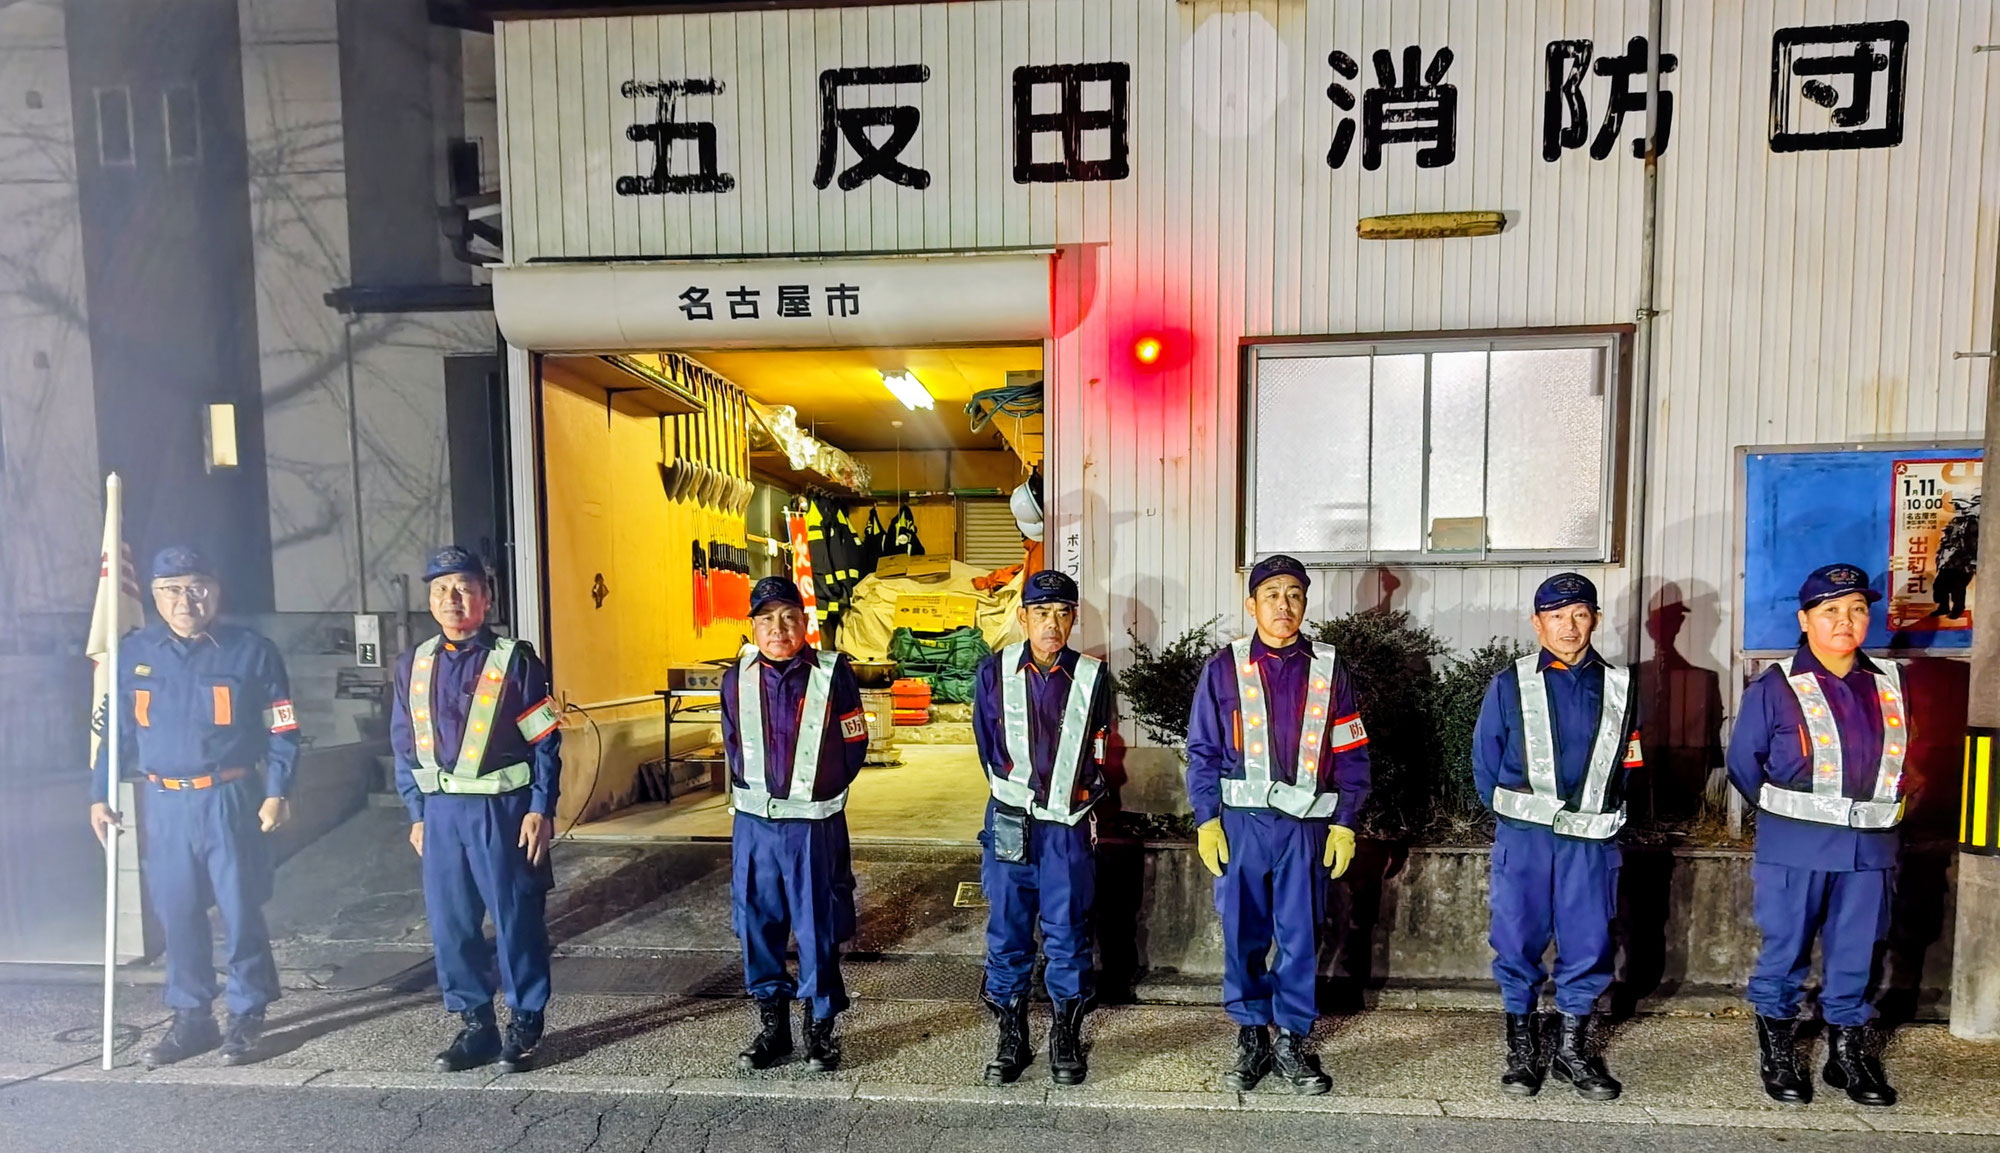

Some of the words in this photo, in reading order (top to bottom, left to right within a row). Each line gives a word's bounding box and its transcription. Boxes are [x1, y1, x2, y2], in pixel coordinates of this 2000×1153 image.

[677, 282, 861, 321] 名古屋市
[1906, 498, 1943, 510] 10:00
